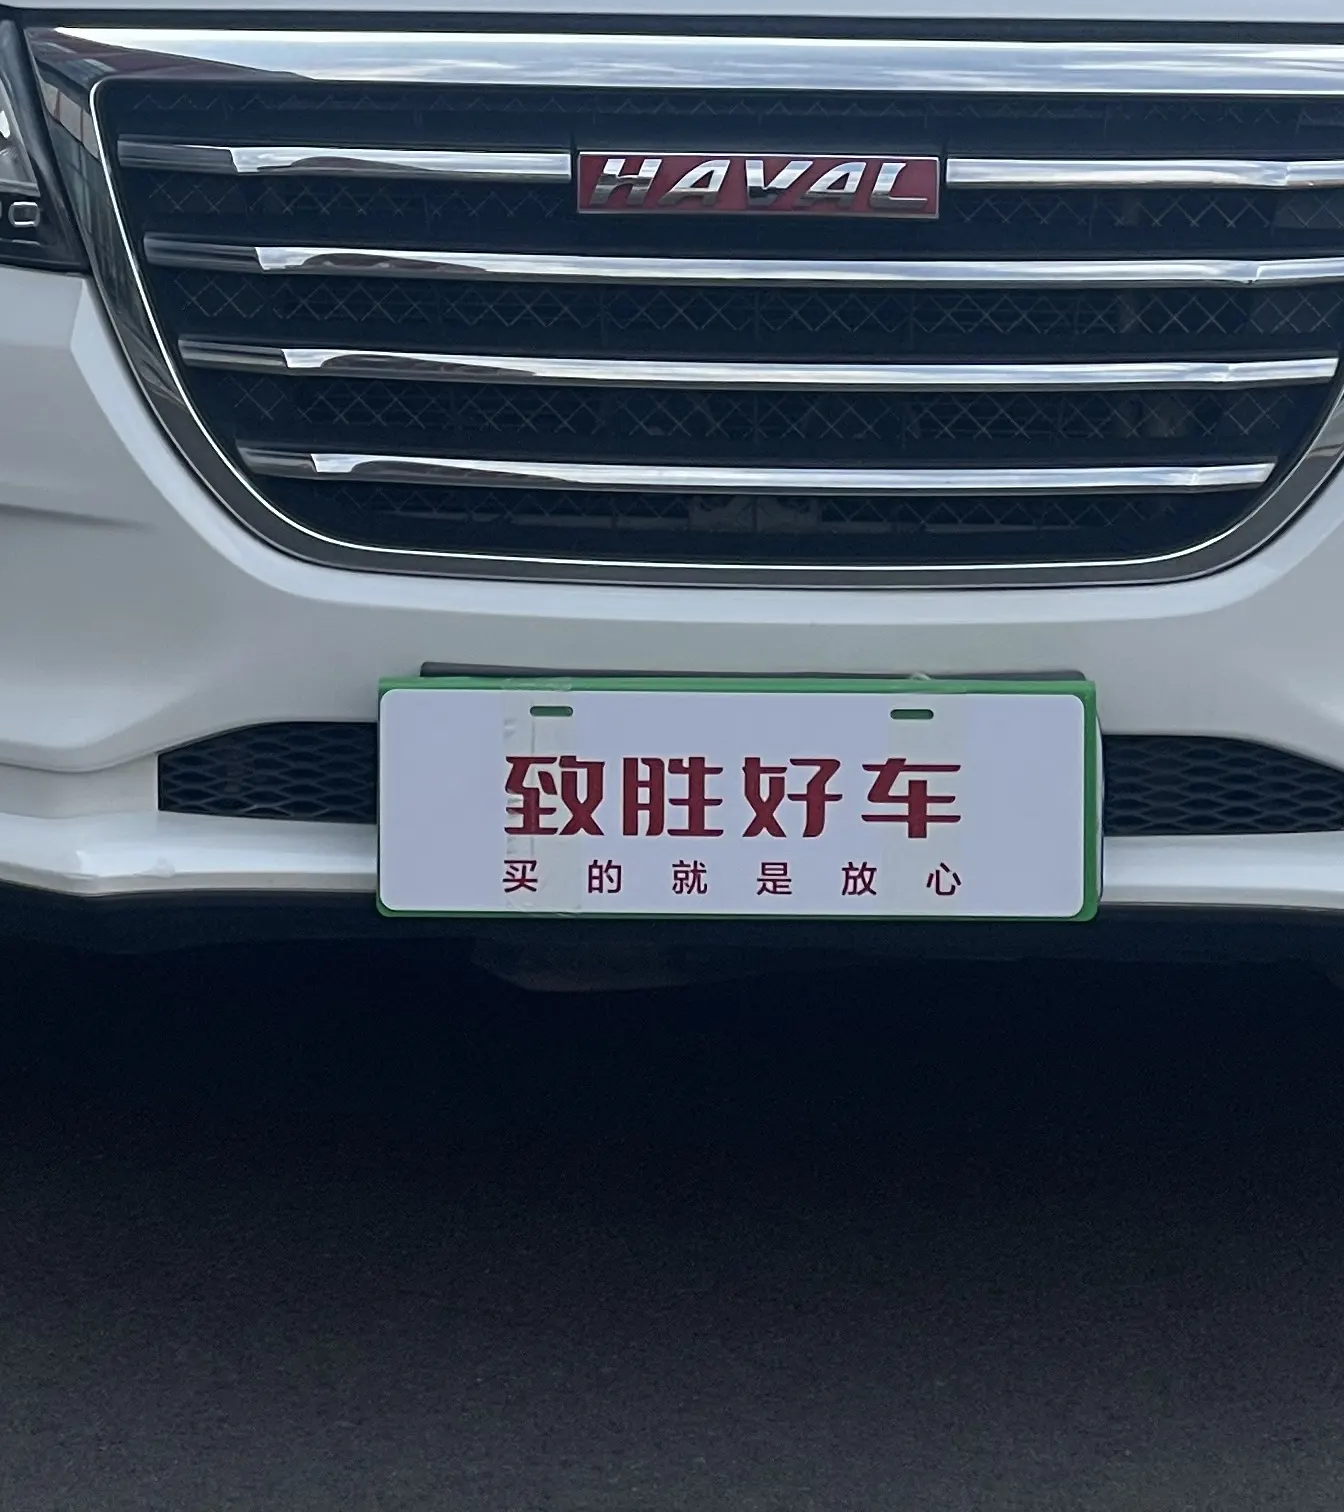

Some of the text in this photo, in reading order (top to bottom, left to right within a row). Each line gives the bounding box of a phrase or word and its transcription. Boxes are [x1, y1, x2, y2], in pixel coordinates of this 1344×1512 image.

[588, 157, 929, 211] HAVAL
[503, 754, 963, 840] 致胜好车
[501, 858, 963, 897] 买的就是放心
